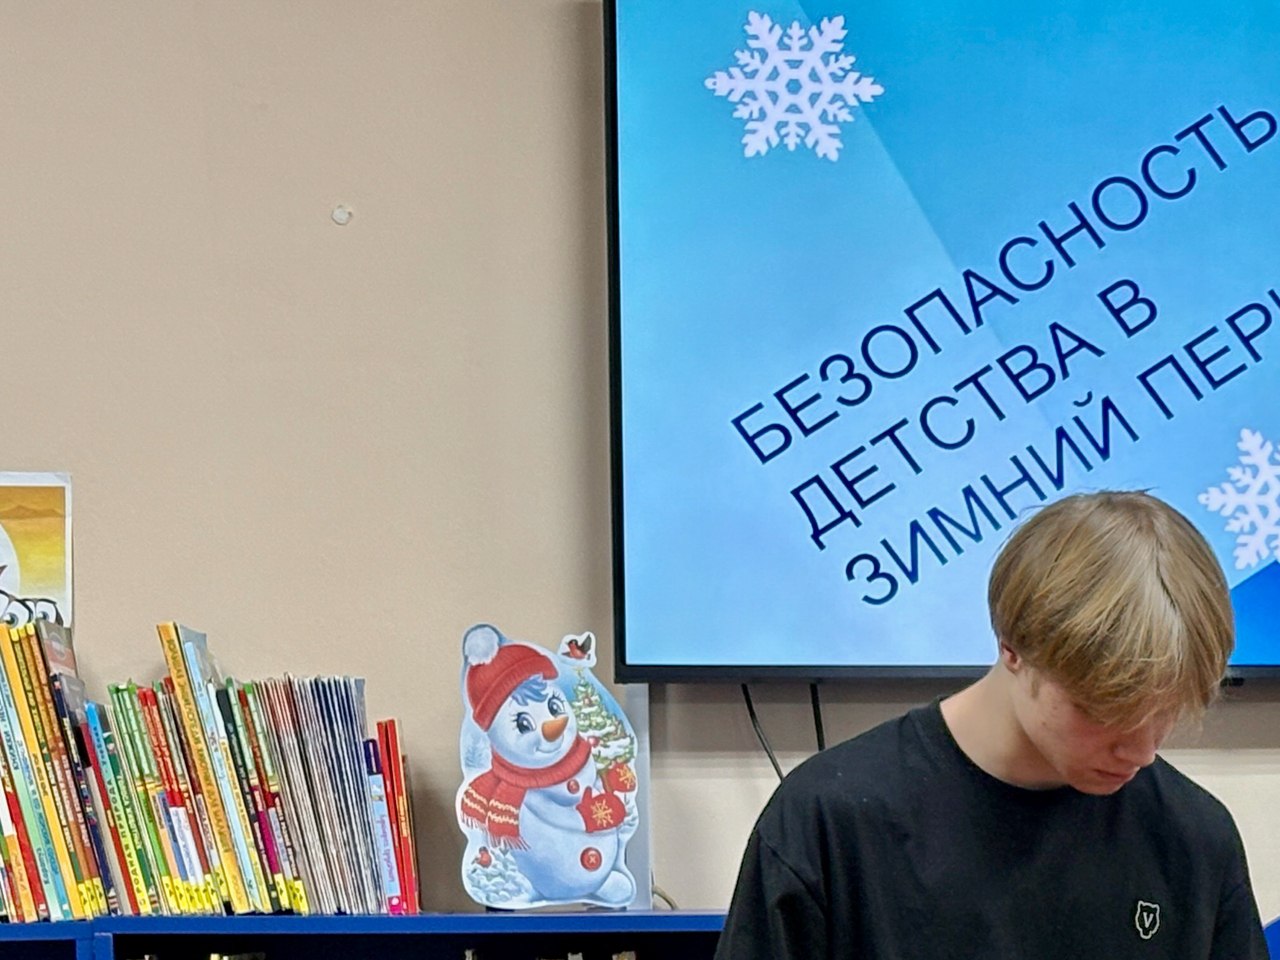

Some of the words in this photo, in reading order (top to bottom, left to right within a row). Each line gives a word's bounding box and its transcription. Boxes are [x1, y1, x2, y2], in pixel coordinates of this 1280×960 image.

[731, 104, 1279, 466] БЕЗОПАСНОСТЬ
[790, 322, 1104, 551] ДЕТСТВА
[1100, 278, 1159, 338] В
[845, 392, 1140, 606] ЗИМНИЙ
